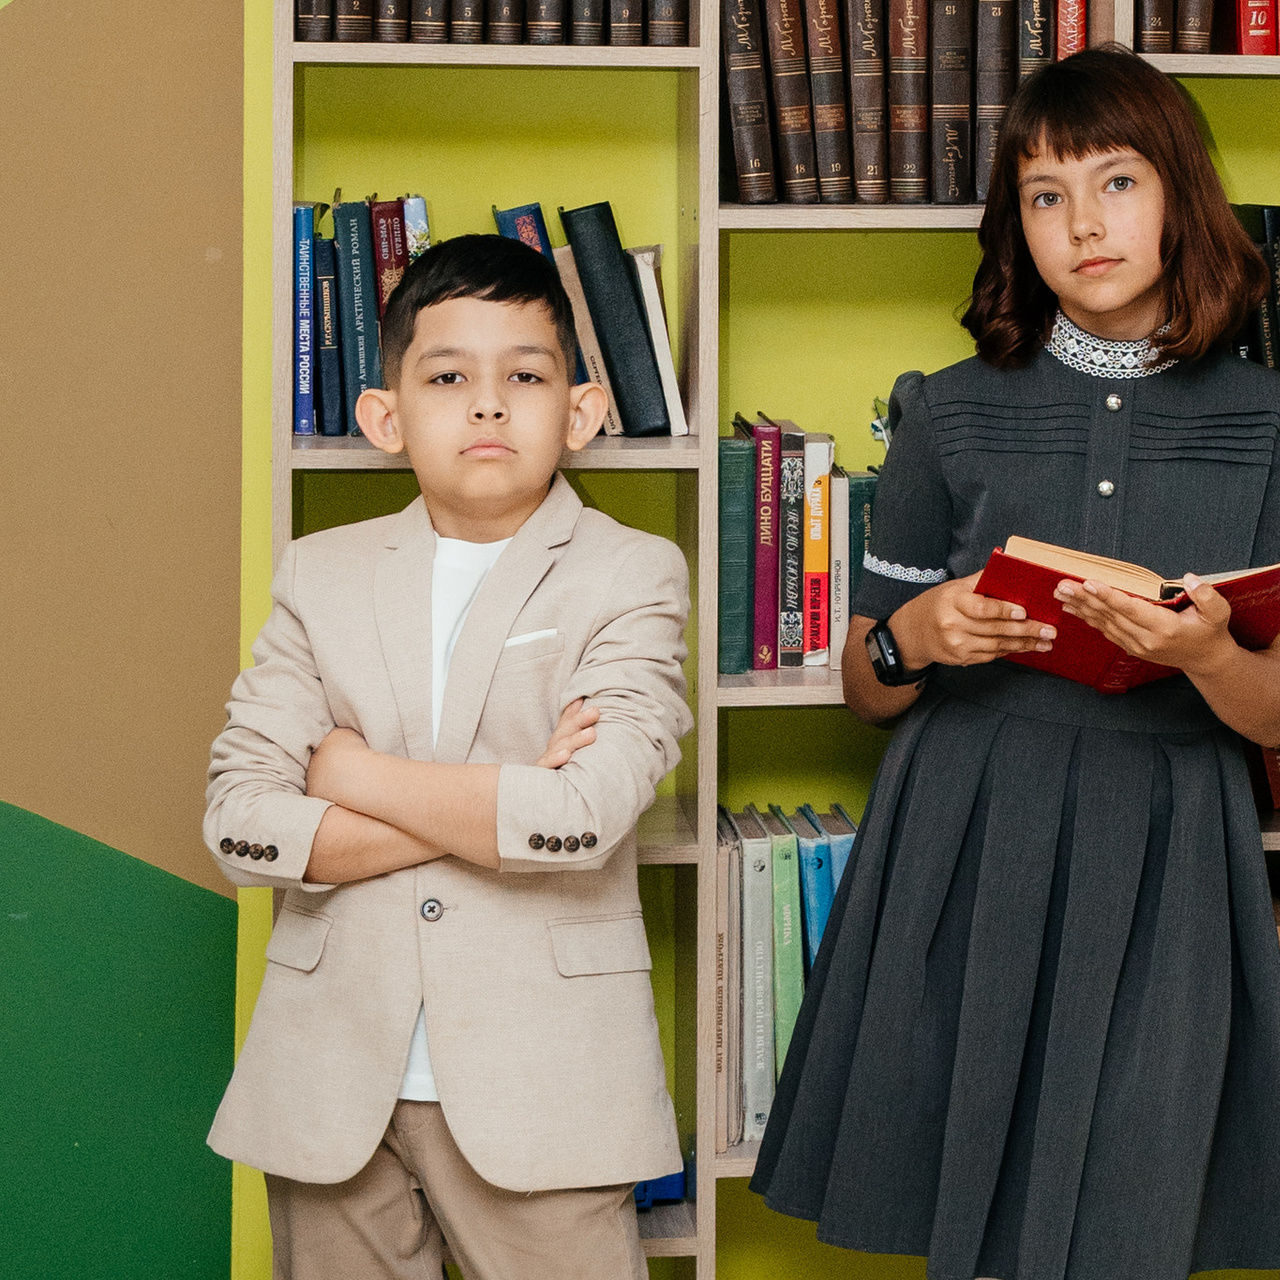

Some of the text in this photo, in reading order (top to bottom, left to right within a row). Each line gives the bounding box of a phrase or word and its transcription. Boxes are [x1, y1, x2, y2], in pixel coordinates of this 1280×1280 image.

[353, 0, 360, 10] 2
[387, 5, 394, 15] 3
[425, 7, 432, 18] 4
[464, 7, 471, 17] 5
[622, 8, 629, 19] 9
[1250, 11, 1267, 26] 10
[750, 159, 760, 168] 16
[795, 164, 805, 174] 18
[831, 163, 841, 172] 19
[903, 164, 915, 173] 22
[350, 218, 359, 254] РОМАН
[352, 258, 364, 332] АРКТИЧЕСКИЙ
[299, 239, 310, 394] ТАИНСТВЕННЫЕ МЕСТА РОССИИ
[760, 440, 774, 546] ДИНО БУЦЦАТИ
[810, 518, 821, 540] ОПЫТ
[783, 904, 792, 946] АФРИКА
[755, 941, 765, 1071] ЗЕМЛЯ И ЧЕЛОВЕЧЕСТВО
